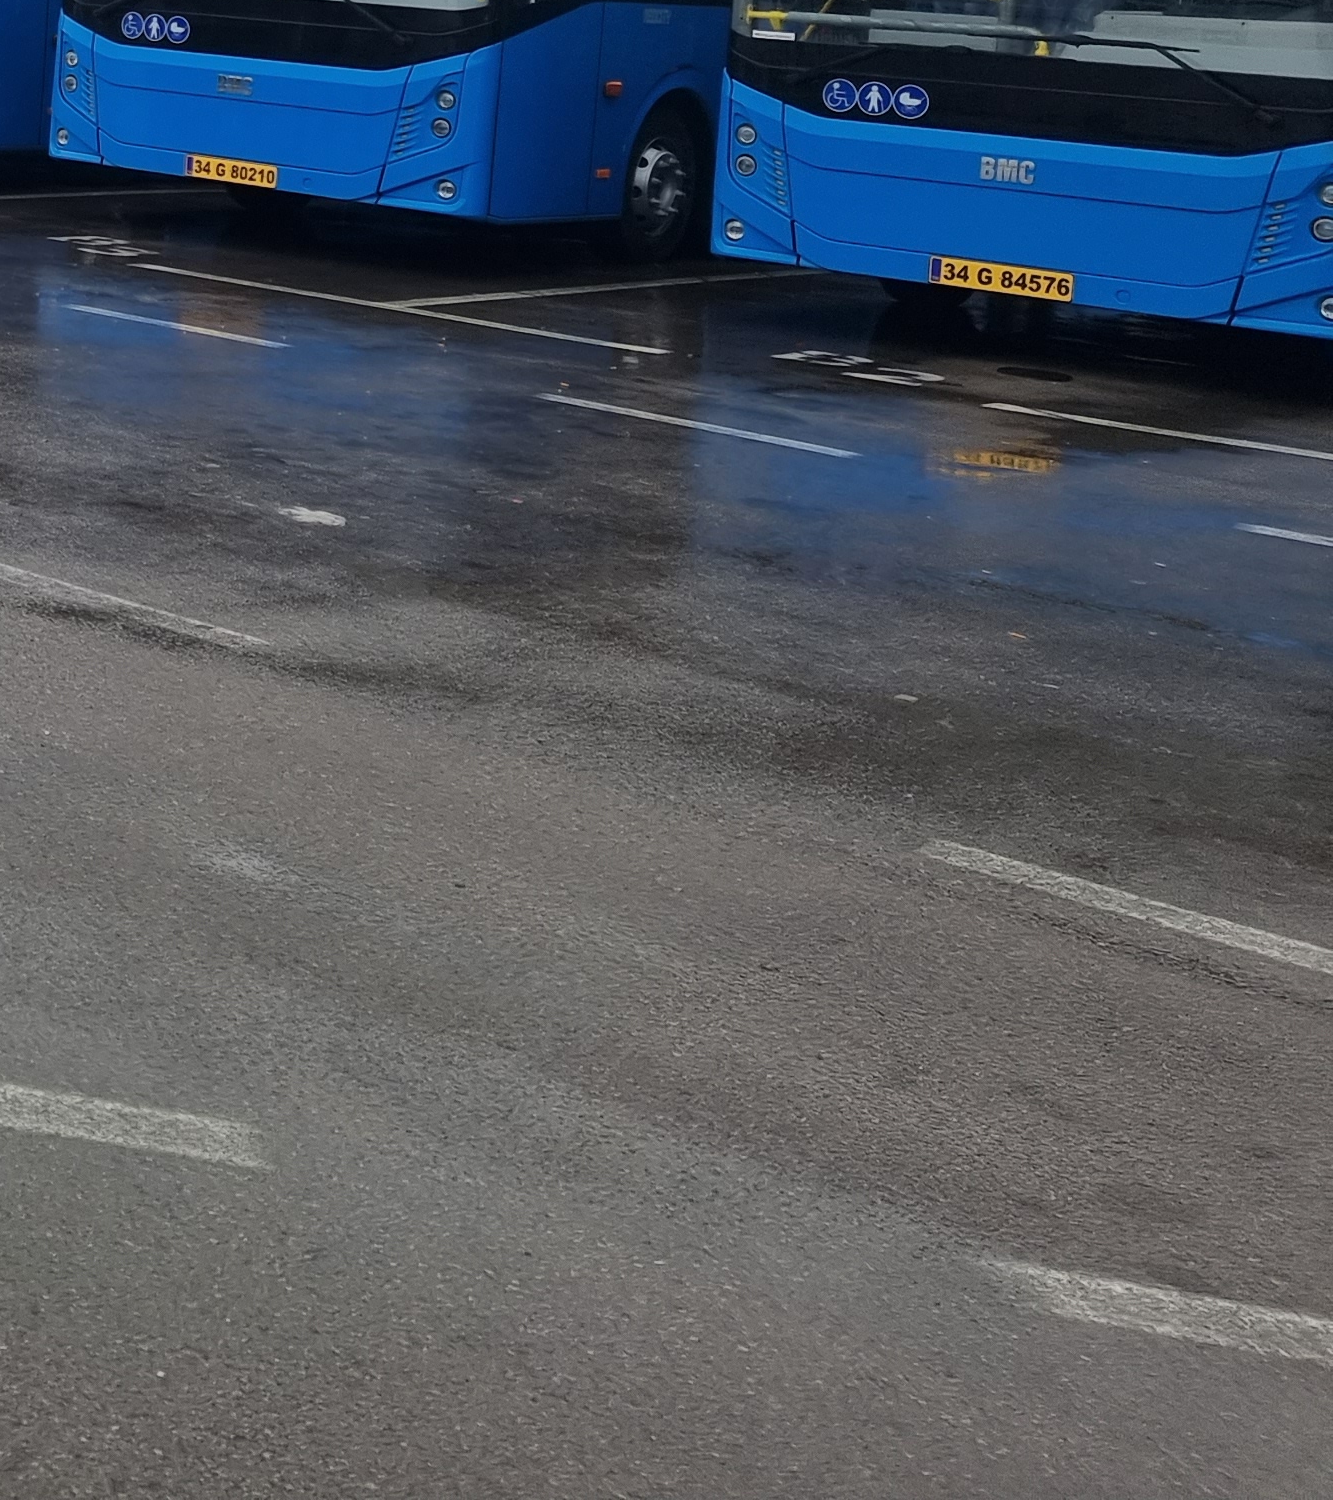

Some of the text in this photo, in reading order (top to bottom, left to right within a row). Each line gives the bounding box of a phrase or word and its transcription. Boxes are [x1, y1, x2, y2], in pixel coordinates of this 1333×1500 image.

[194, 160, 275, 184] 34 G 80210
[980, 156, 1035, 185] BMC
[943, 263, 1070, 297] 34 G 84576
